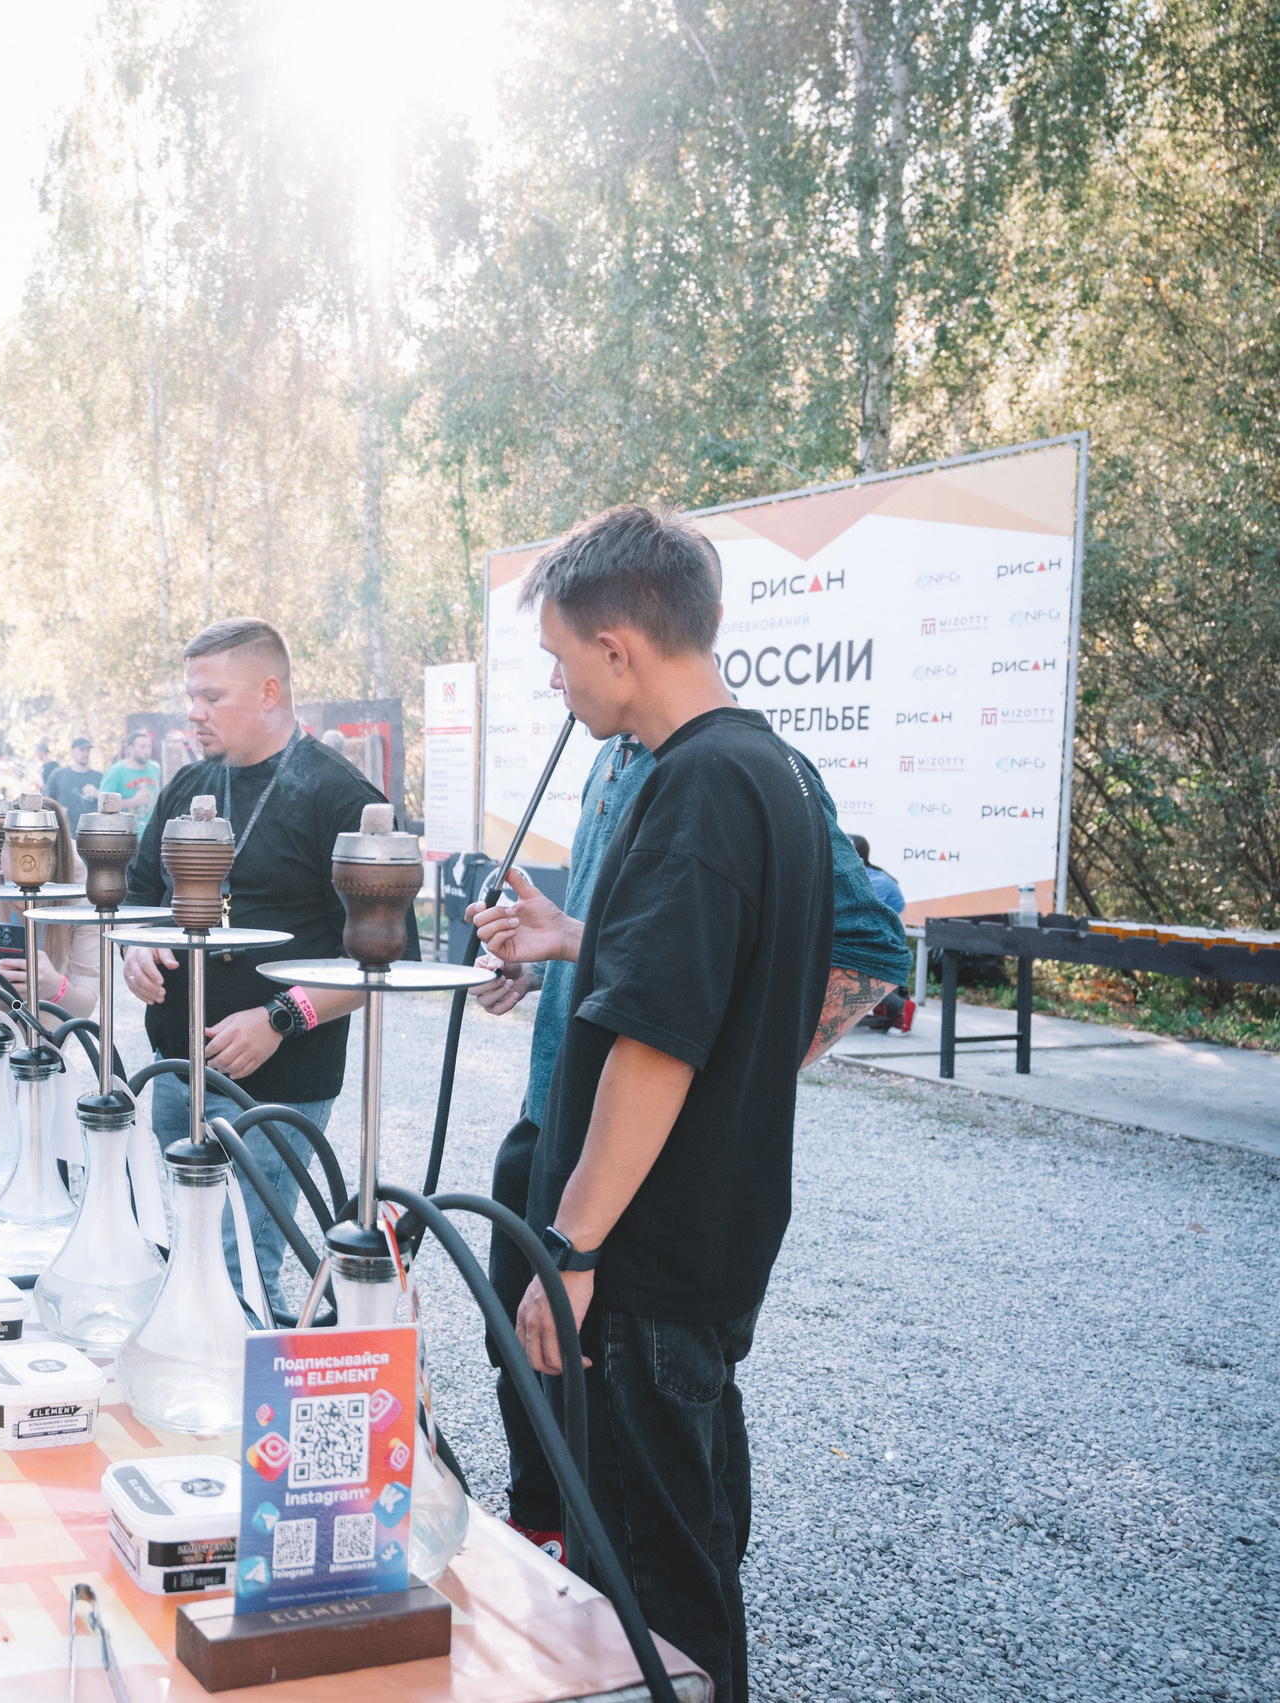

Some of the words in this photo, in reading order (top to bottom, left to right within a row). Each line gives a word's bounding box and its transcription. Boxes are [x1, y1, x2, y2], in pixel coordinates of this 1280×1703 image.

[720, 613, 810, 634] ОРЕВНОВАНИЙ
[714, 638, 873, 689] ОССИИ
[766, 706, 870, 732] ТРЕЛЬБЕ
[1001, 707, 1055, 718] MIZOTTY
[917, 757, 965, 767] MIZOTTY
[273, 1351, 390, 1372] Подписывайся
[284, 1375, 304, 1388] на
[306, 1367, 379, 1387] ELEMENT
[32, 1406, 76, 1417] ELEMENT
[272, 1567, 315, 1579] Telegram
[329, 1561, 378, 1574] ВКонтакте
[270, 1600, 372, 1624] ELEMENT
